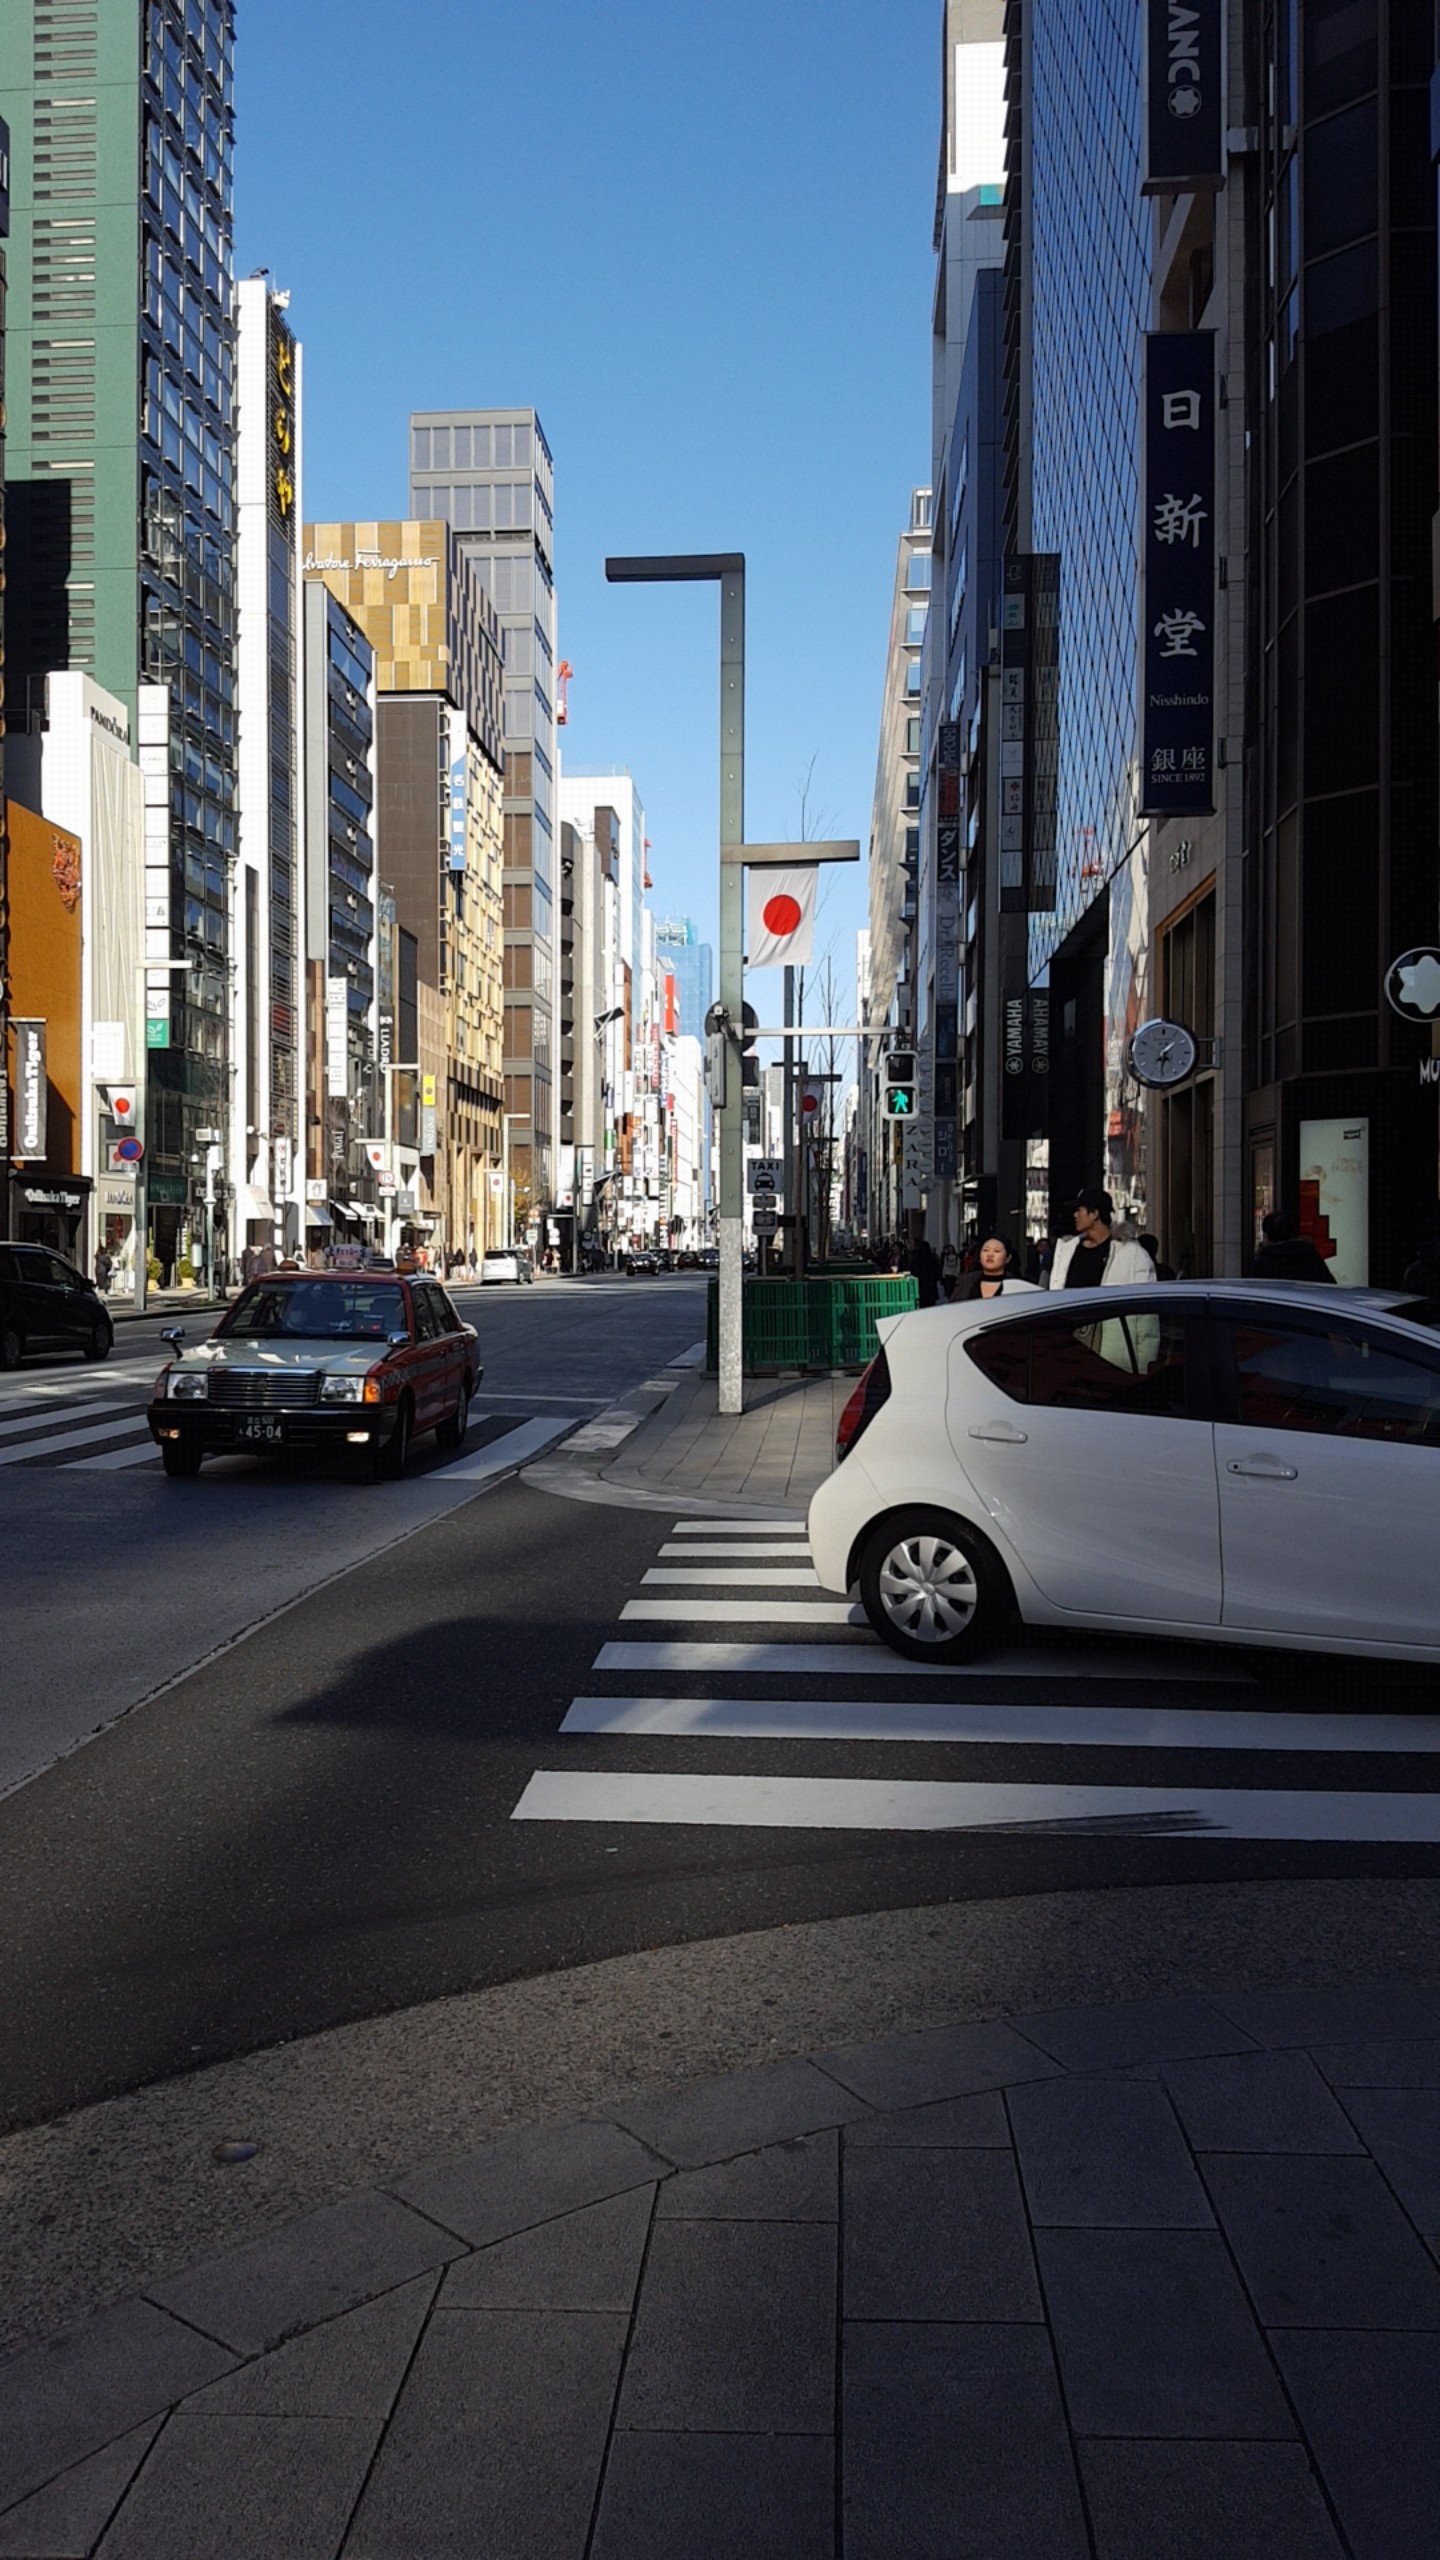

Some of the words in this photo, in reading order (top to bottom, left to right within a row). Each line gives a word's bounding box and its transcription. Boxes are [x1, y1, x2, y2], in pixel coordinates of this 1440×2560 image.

[1168, 0, 1200, 84] ANC
[1153, 389, 1208, 658] 日新堂
[354, 550, 440, 580] Ferragamo
[1150, 694, 1209, 706] Nisshindo
[1151, 746, 1206, 772] 銀座
[1151, 774, 1182, 784] SINCE
[1184, 772, 1206, 783] 1892
[940, 829, 957, 880] ダンス
[1007, 999, 1022, 1056] YAMAHA
[25, 1031, 41, 1078] Tiger
[24, 1078, 38, 1148] Onitsuka
[752, 1161, 780, 1170] TAXI
[906, 1125, 919, 1188] ZARA
[246, 1425, 282, 1438] 45-04
